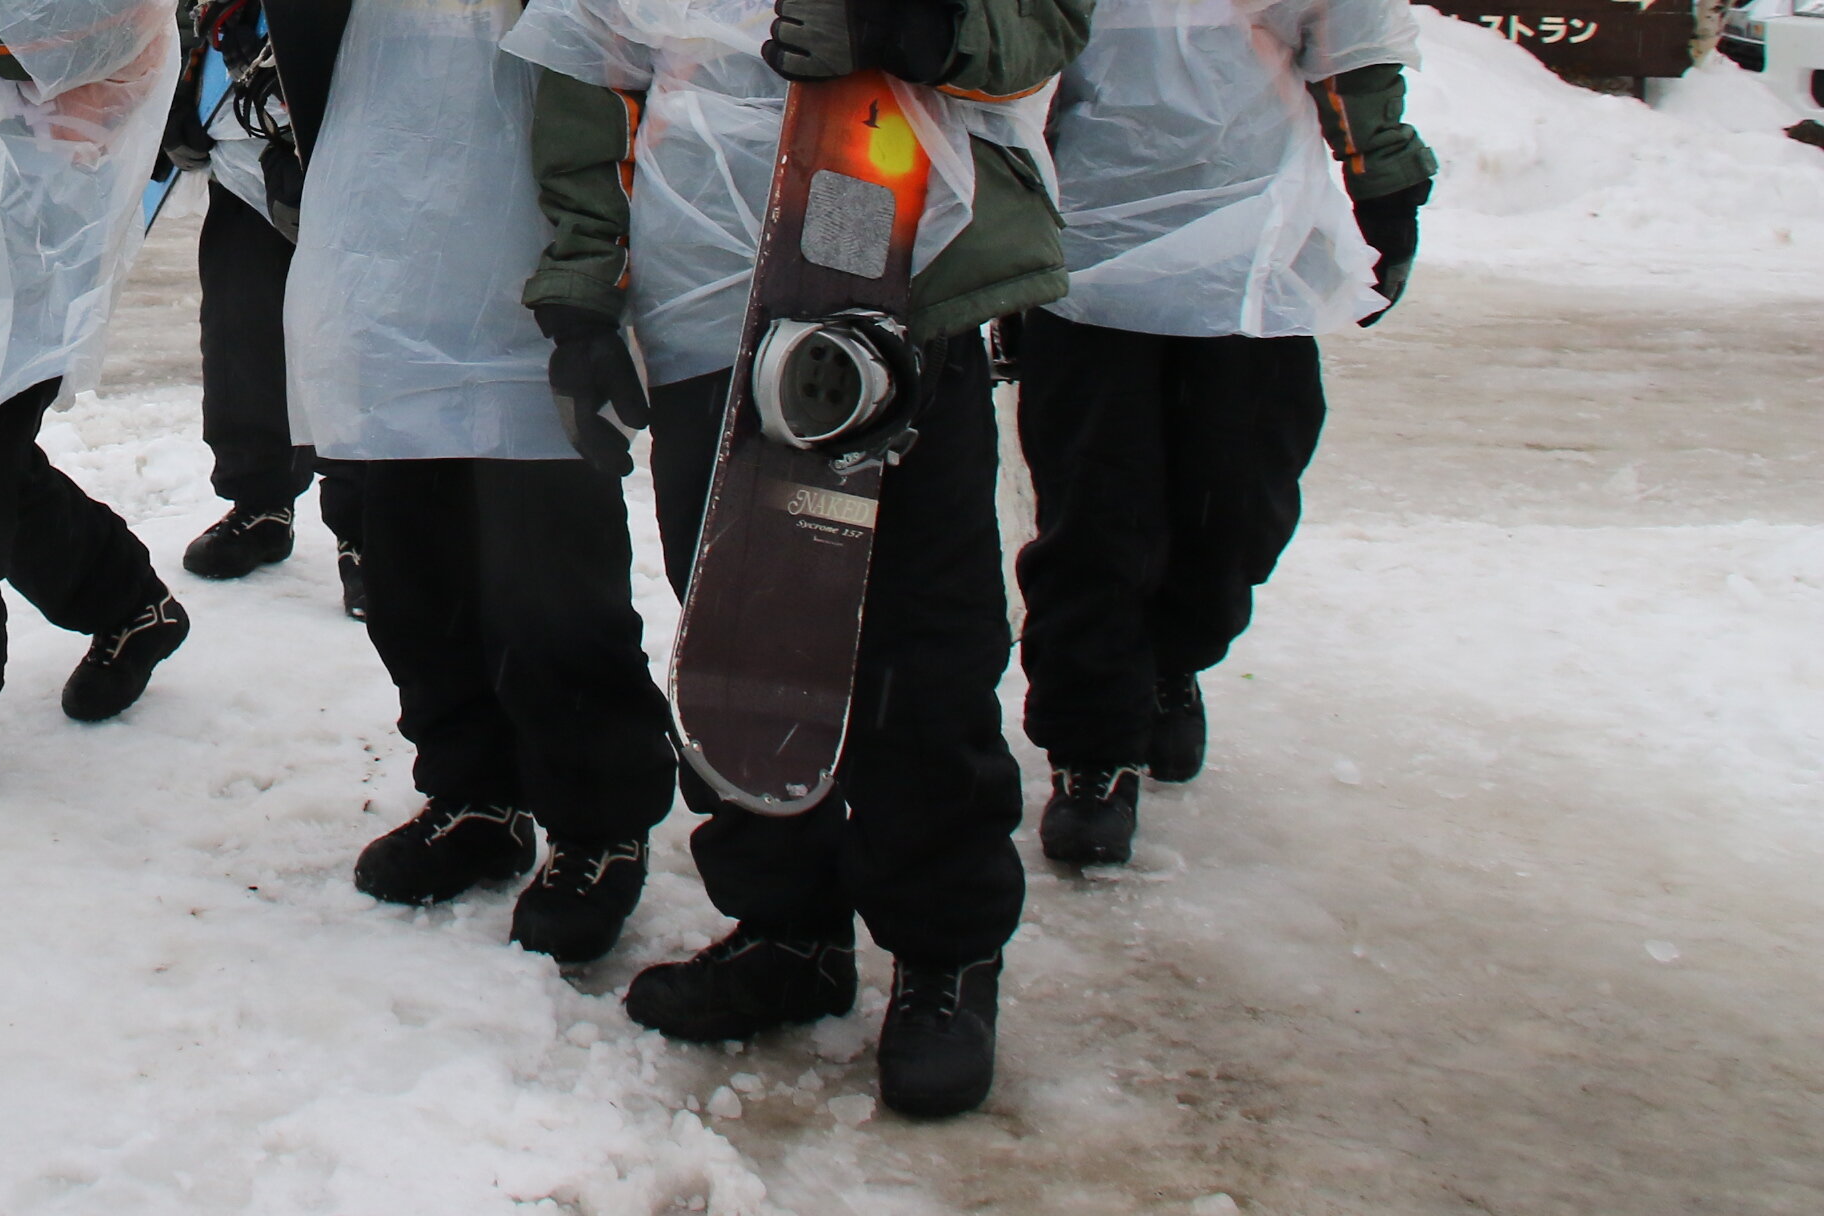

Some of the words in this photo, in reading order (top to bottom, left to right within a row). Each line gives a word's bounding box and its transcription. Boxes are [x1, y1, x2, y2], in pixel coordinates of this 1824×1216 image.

[1449, 13, 1598, 44] ストラン
[787, 489, 870, 523] NAKED
[842, 527, 864, 539] 157
